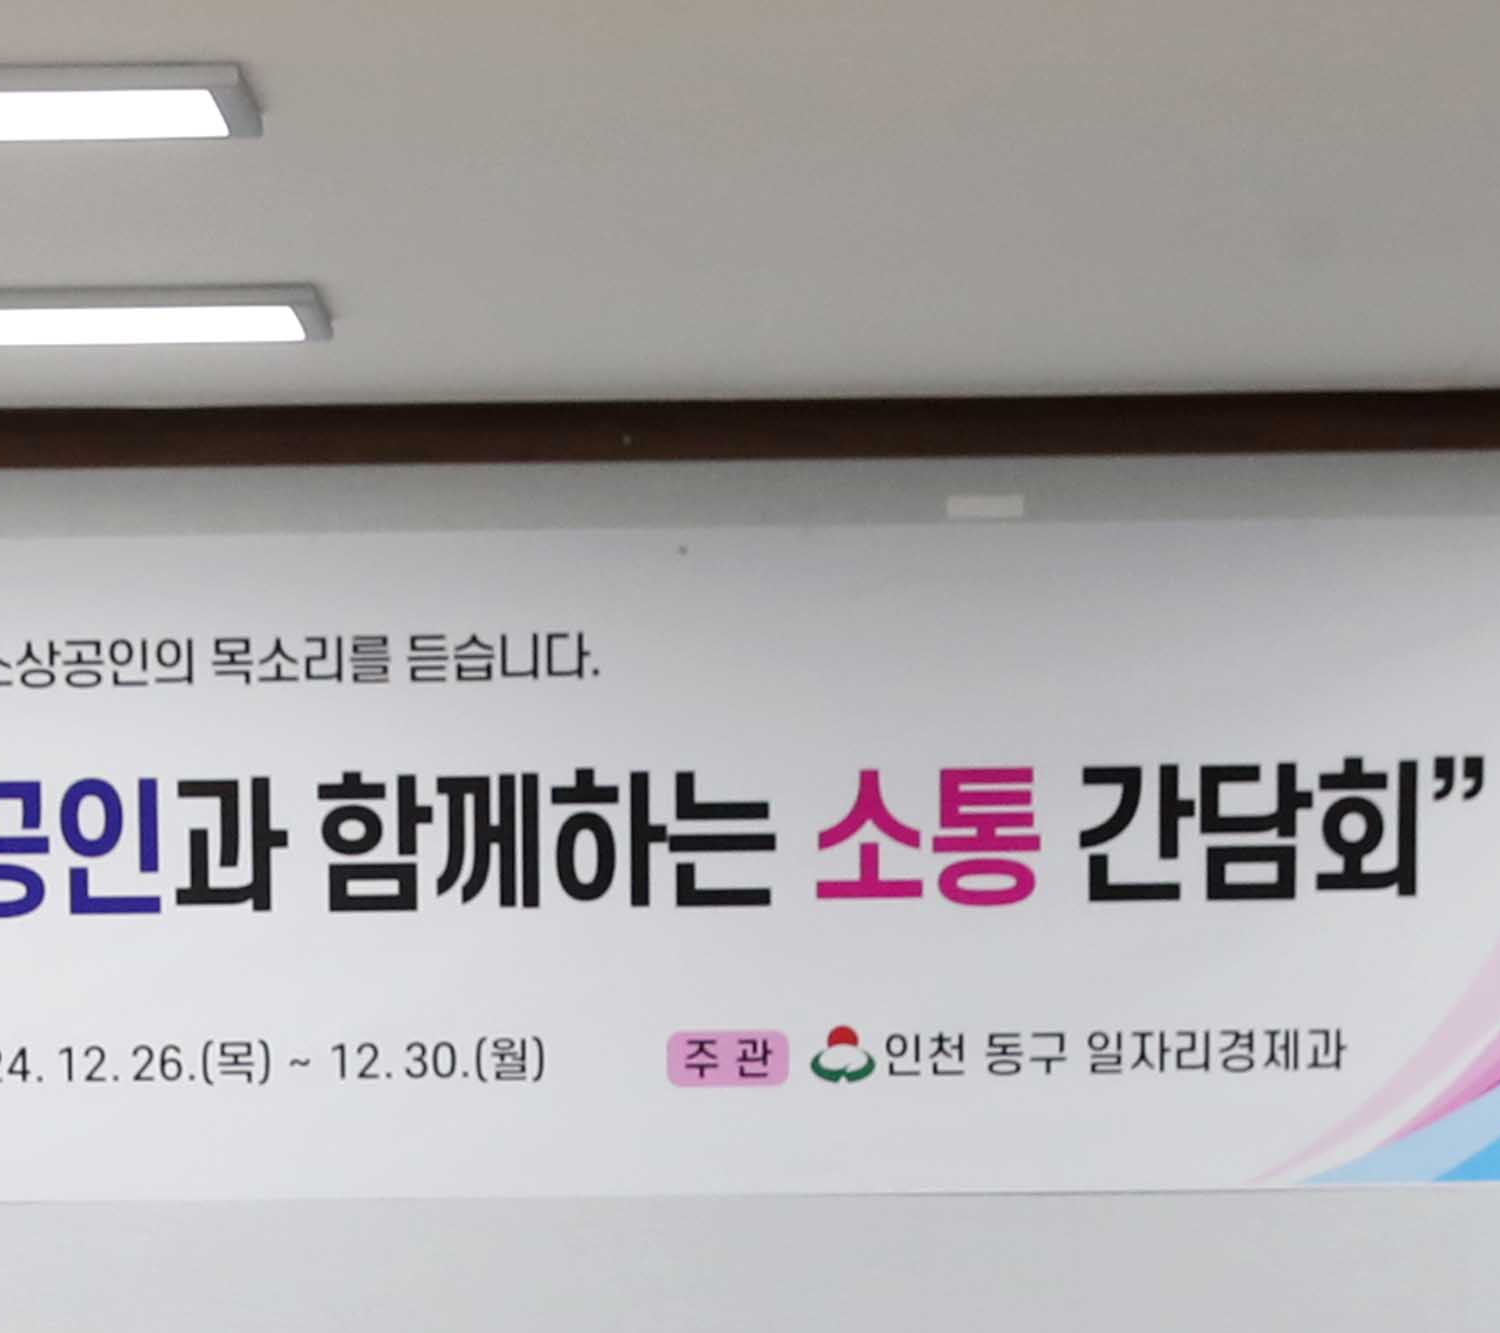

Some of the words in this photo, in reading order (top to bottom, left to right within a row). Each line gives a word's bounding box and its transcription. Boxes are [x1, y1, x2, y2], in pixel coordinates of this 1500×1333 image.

[211, 633, 392, 686] 목소리를
[406, 631, 601, 684] 듣습니다.
[316, 766, 778, 913] 함께하는
[814, 764, 1043, 908] 소통
[1076, 754, 1486, 904] 간담회”
[884, 1031, 966, 1077] 인천
[985, 1030, 1068, 1076] 동구
[1086, 1028, 1348, 1075] 일자리경제과
